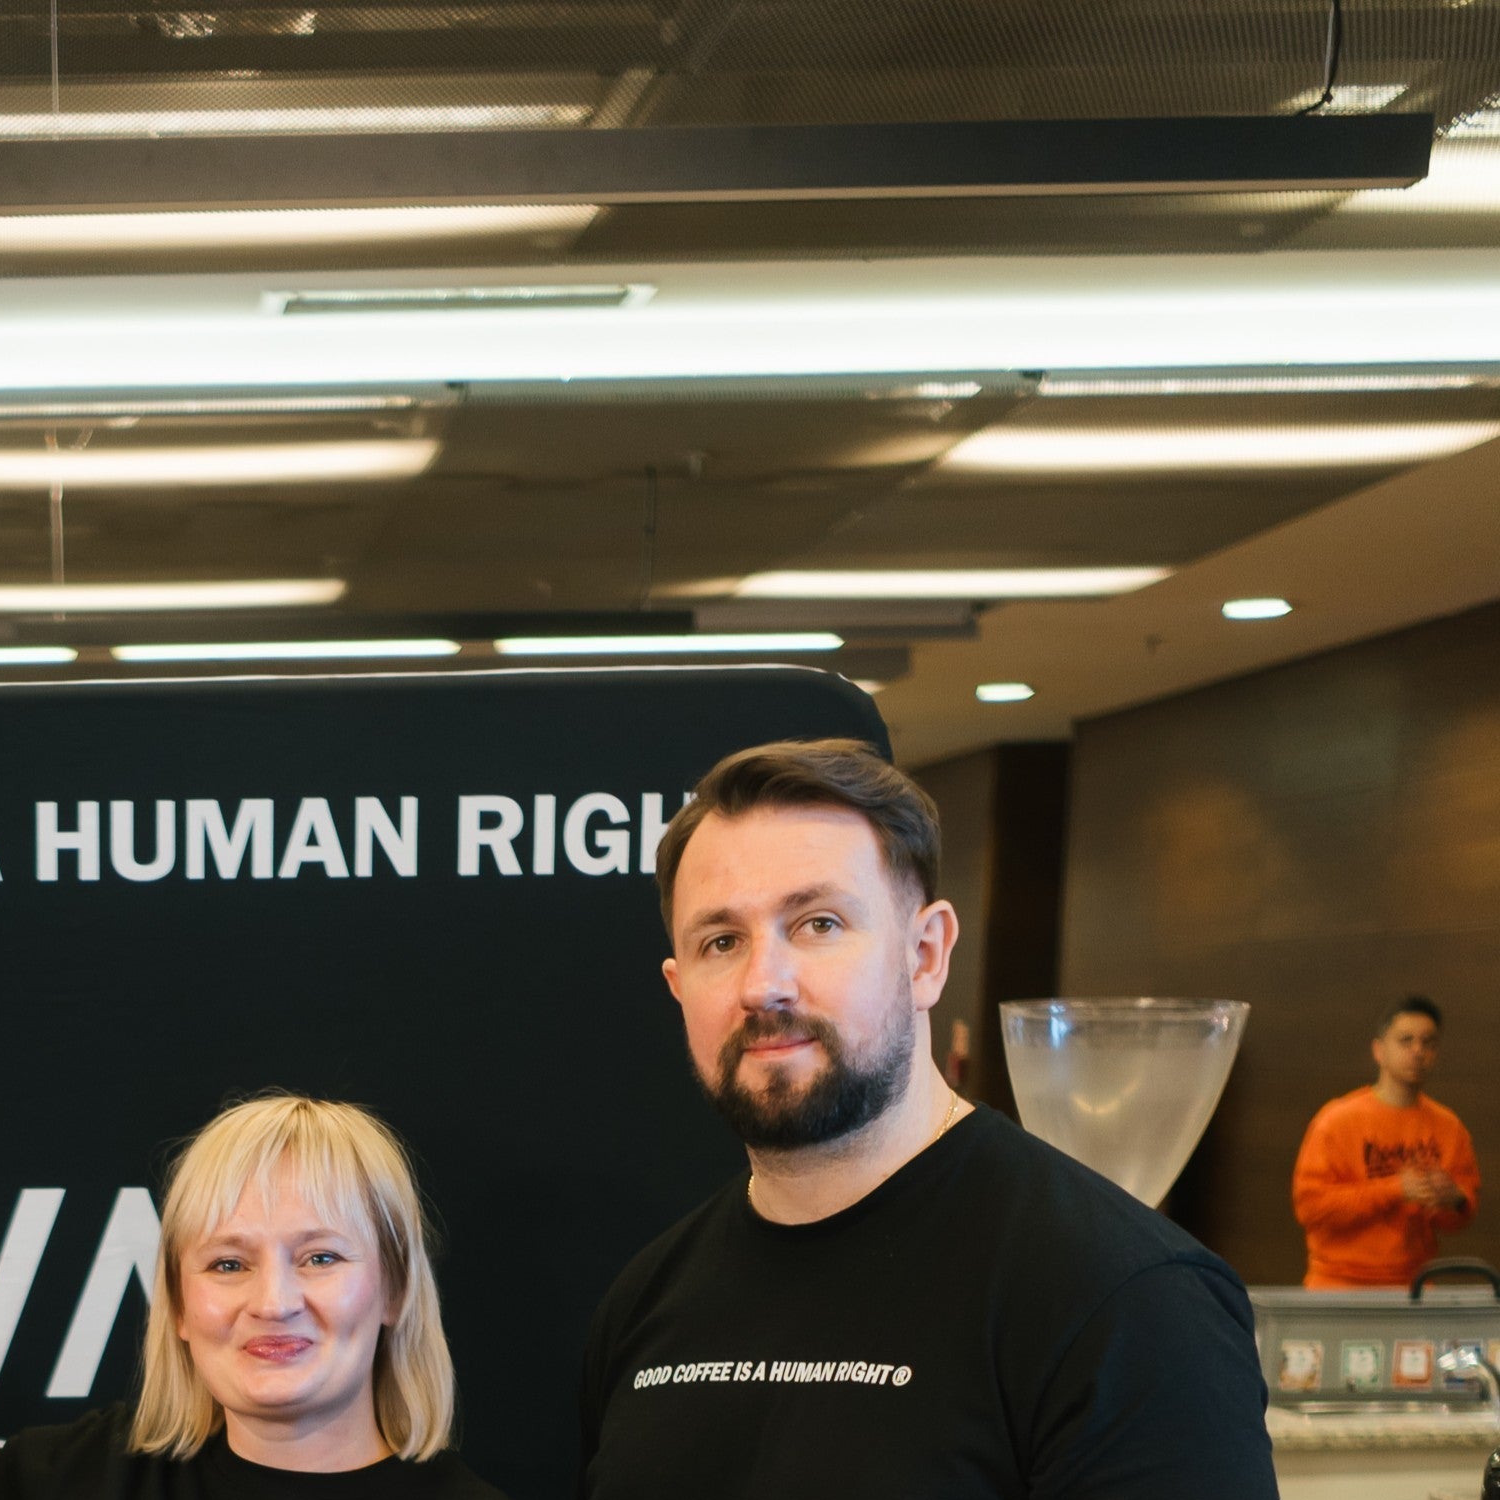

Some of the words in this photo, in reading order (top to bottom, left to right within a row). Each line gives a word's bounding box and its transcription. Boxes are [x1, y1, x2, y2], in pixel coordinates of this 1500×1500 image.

[36, 796, 419, 882] HUMAN
[457, 792, 697, 876] RIGH
[633, 1366, 672, 1389] GOOD
[672, 1362, 735, 1383] COFFEE
[734, 1361, 753, 1382] IS
[751, 1361, 767, 1382] A
[768, 1361, 836, 1383] HUMAN
